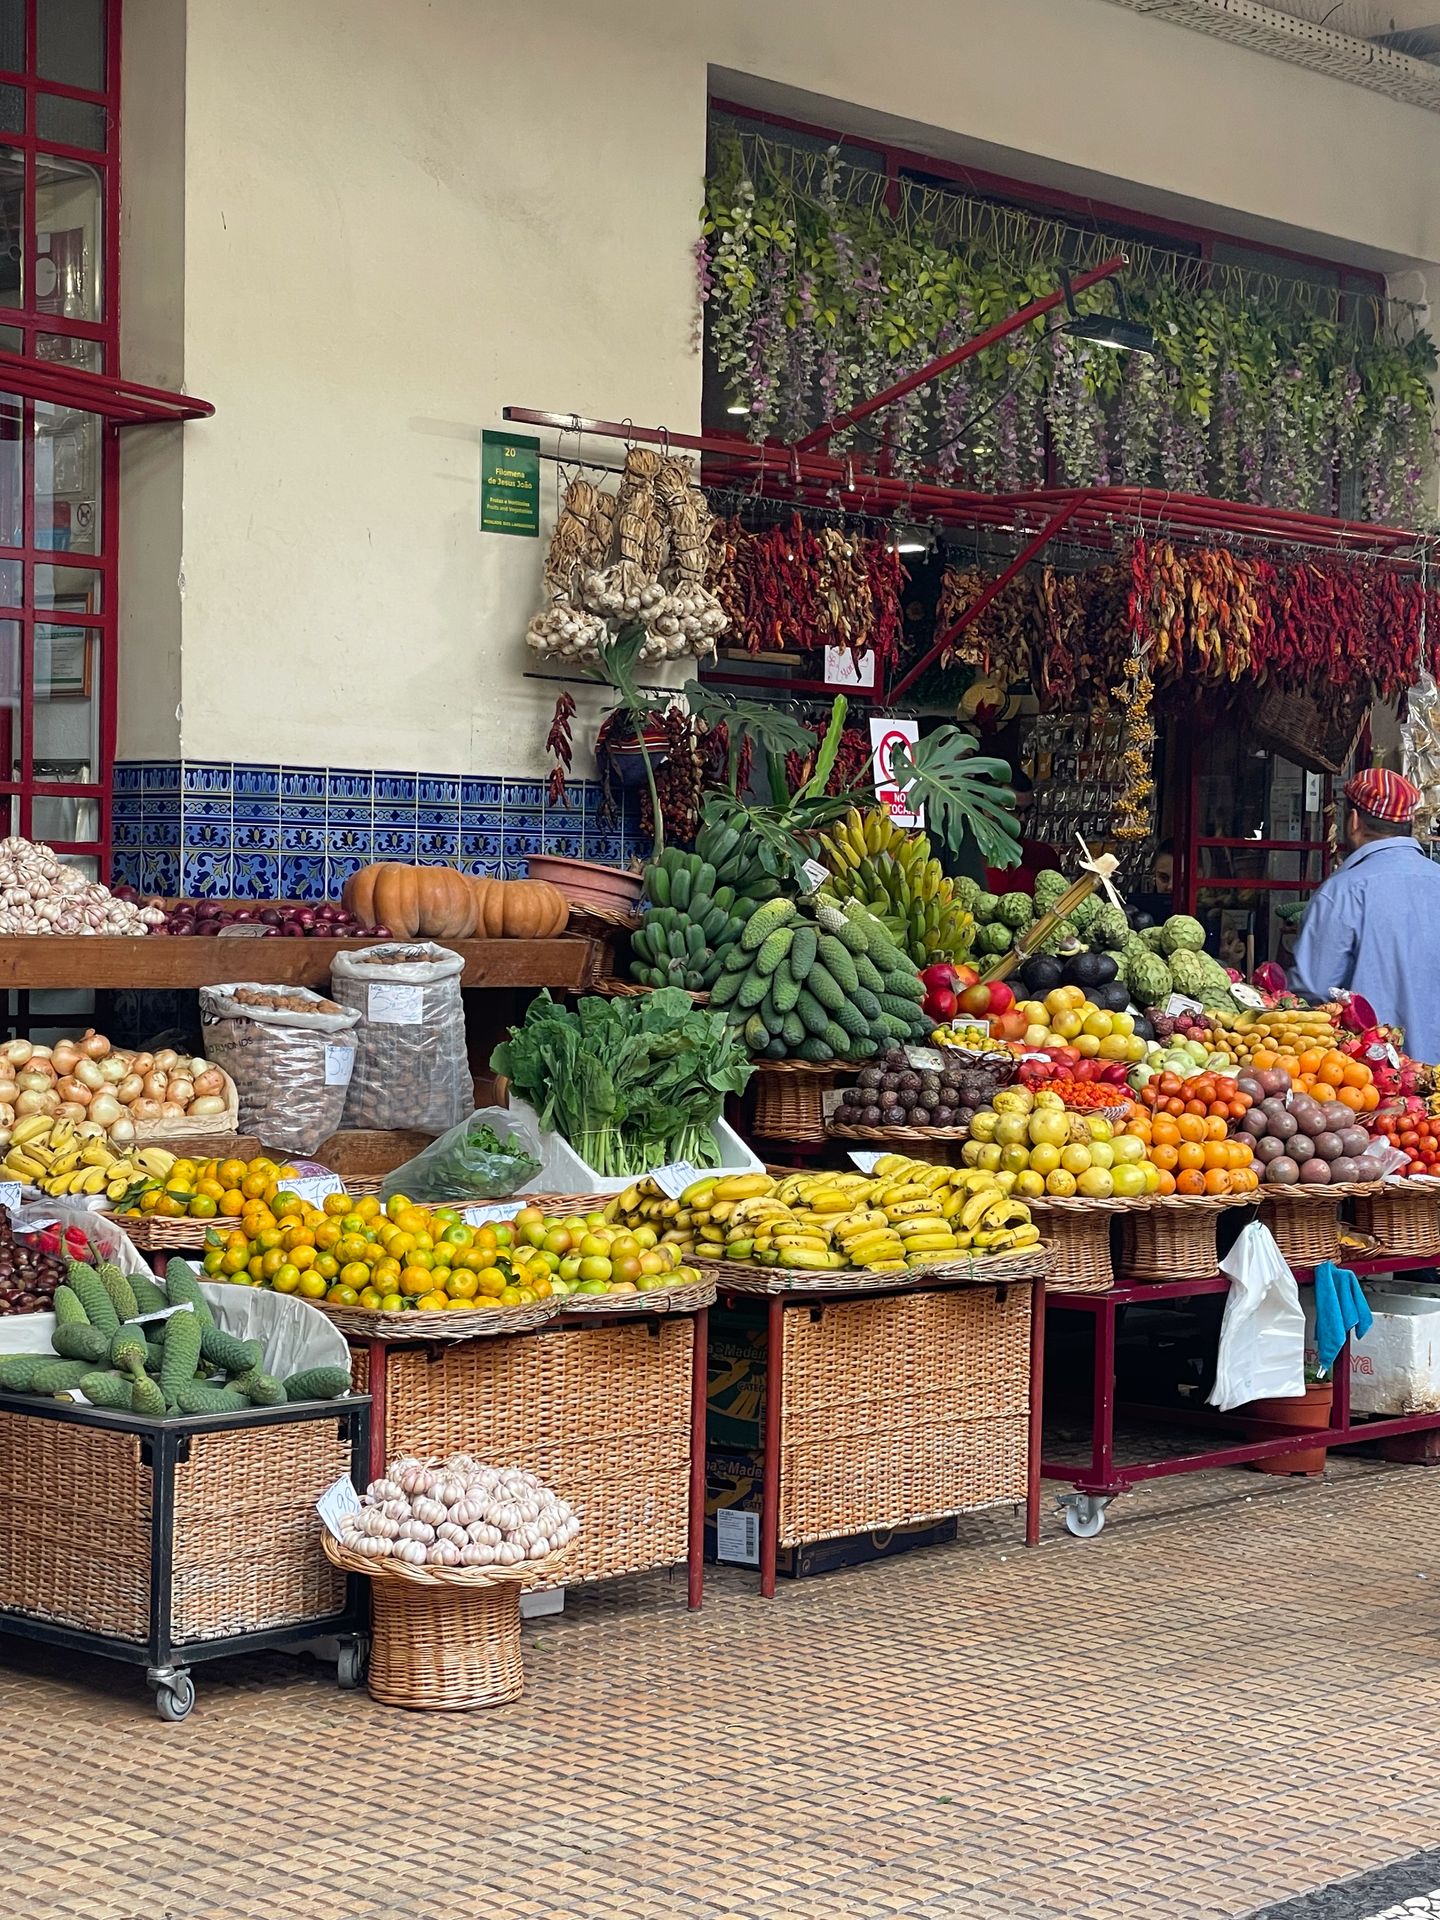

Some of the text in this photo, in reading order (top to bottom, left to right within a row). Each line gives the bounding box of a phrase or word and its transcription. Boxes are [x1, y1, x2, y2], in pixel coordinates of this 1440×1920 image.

[504, 448, 516, 458] 20
[495, 467, 525, 479] Filomena
[488, 476, 497, 485] de
[497, 477, 516, 487] Jesus
[894, 792, 906, 803] NO
[724, 1343, 766, 1360] Madeir
[728, 1461, 764, 1478] Made
